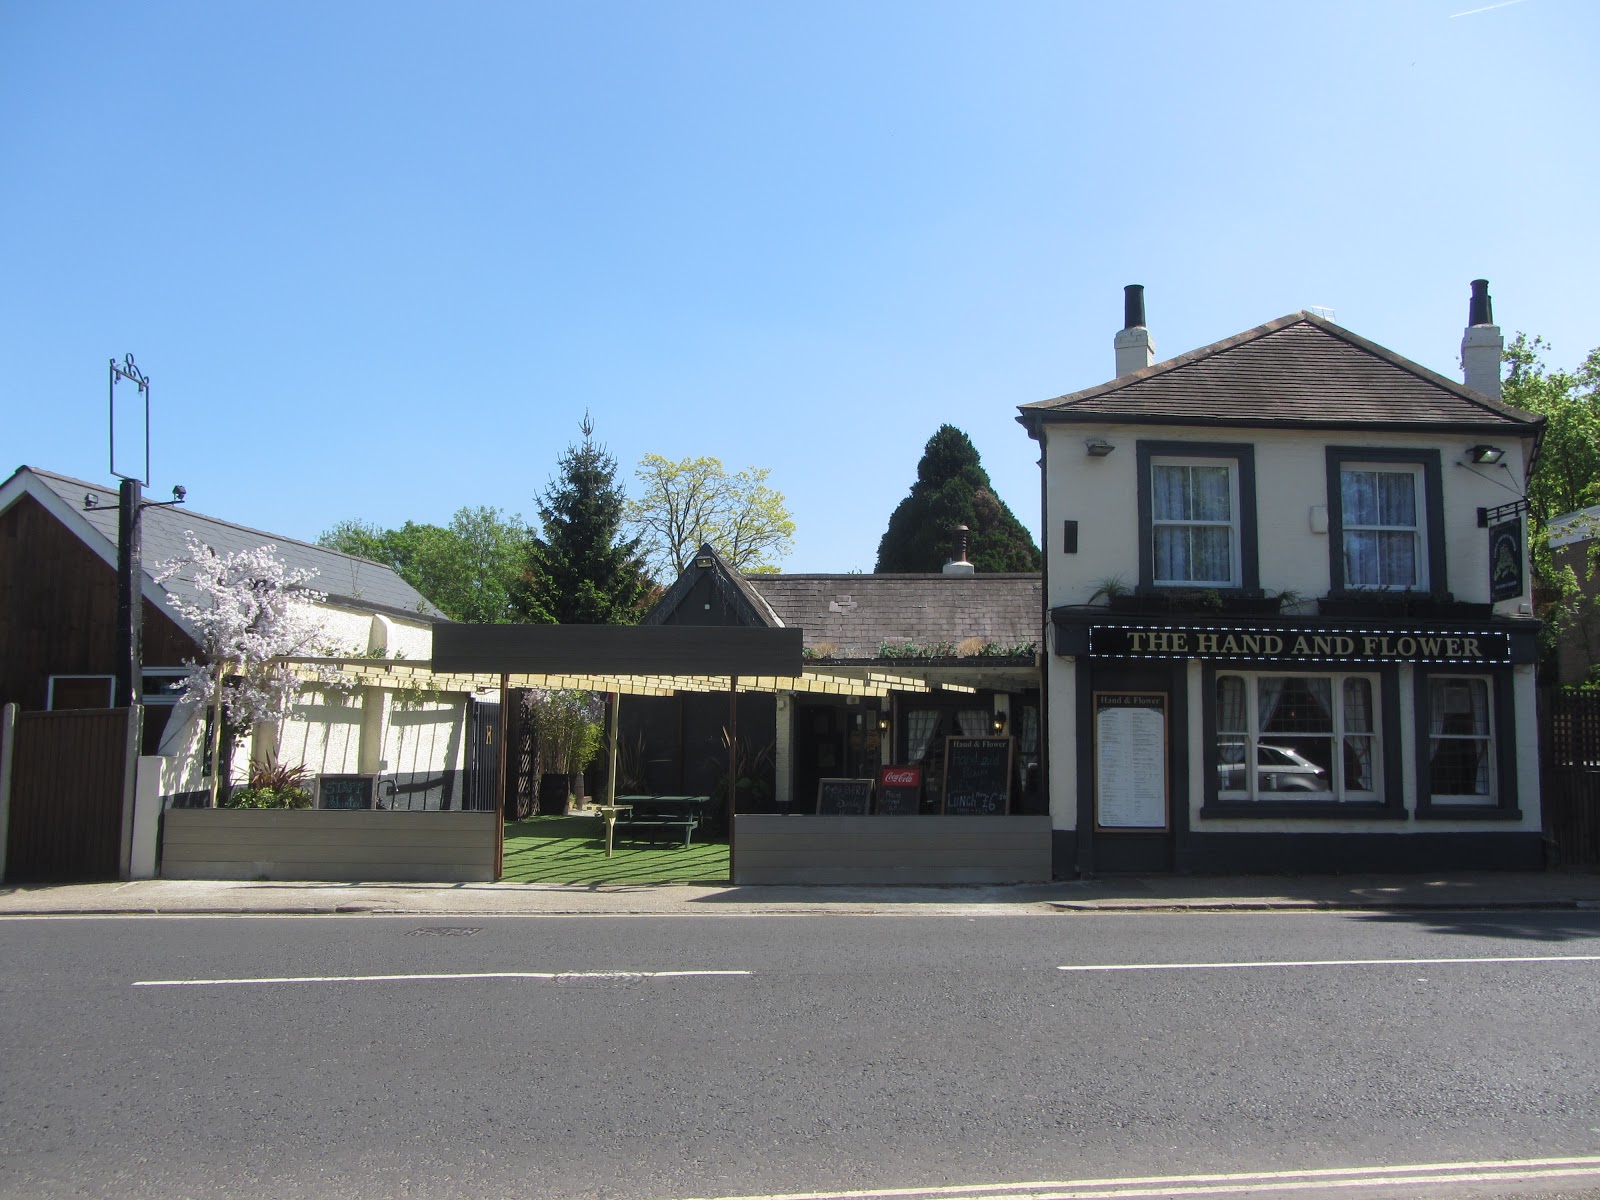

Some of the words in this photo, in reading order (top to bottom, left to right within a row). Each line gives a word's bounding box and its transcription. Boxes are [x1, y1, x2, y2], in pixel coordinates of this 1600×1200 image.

[1127, 632, 1189, 652] THE
[1196, 633, 1284, 654] HAND
[1291, 635, 1355, 655] AND
[1362, 636, 1483, 657] FLOWER
[1101, 696, 1122, 704] Hand
[1123, 696, 1131, 704] &
[1133, 696, 1160, 704] Flower
[982, 740, 1007, 748] Flower
[325, 781, 365, 795] STAFF
